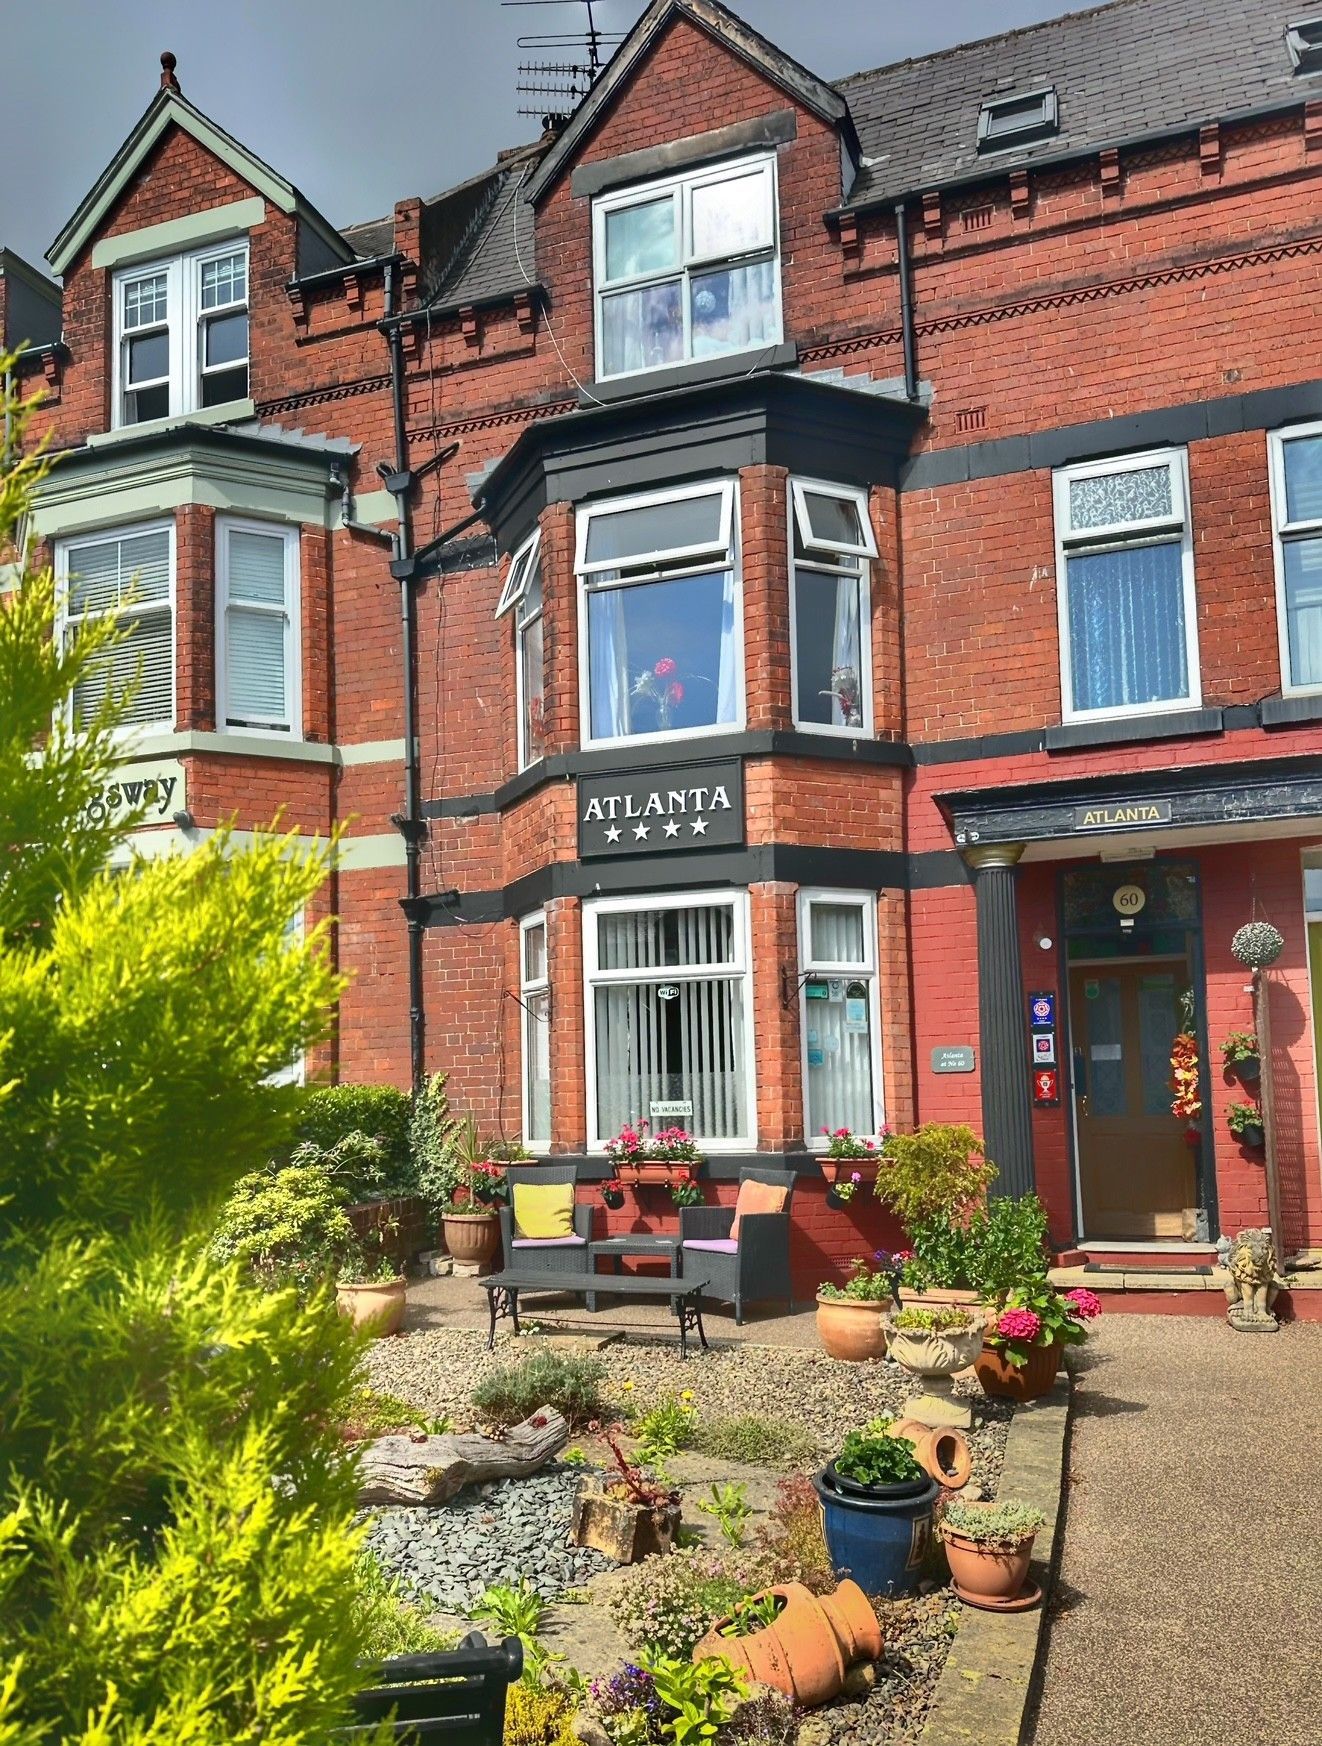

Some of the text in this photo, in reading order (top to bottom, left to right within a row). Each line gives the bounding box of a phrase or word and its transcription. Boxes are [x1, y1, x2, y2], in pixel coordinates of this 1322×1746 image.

[84, 776, 178, 824] gsway
[583, 785, 732, 822] ATLANTA
[1083, 806, 1160, 824] ATLANTA
[1120, 892, 1139, 907] 60
[661, 1105, 691, 1113] VACANCIES
